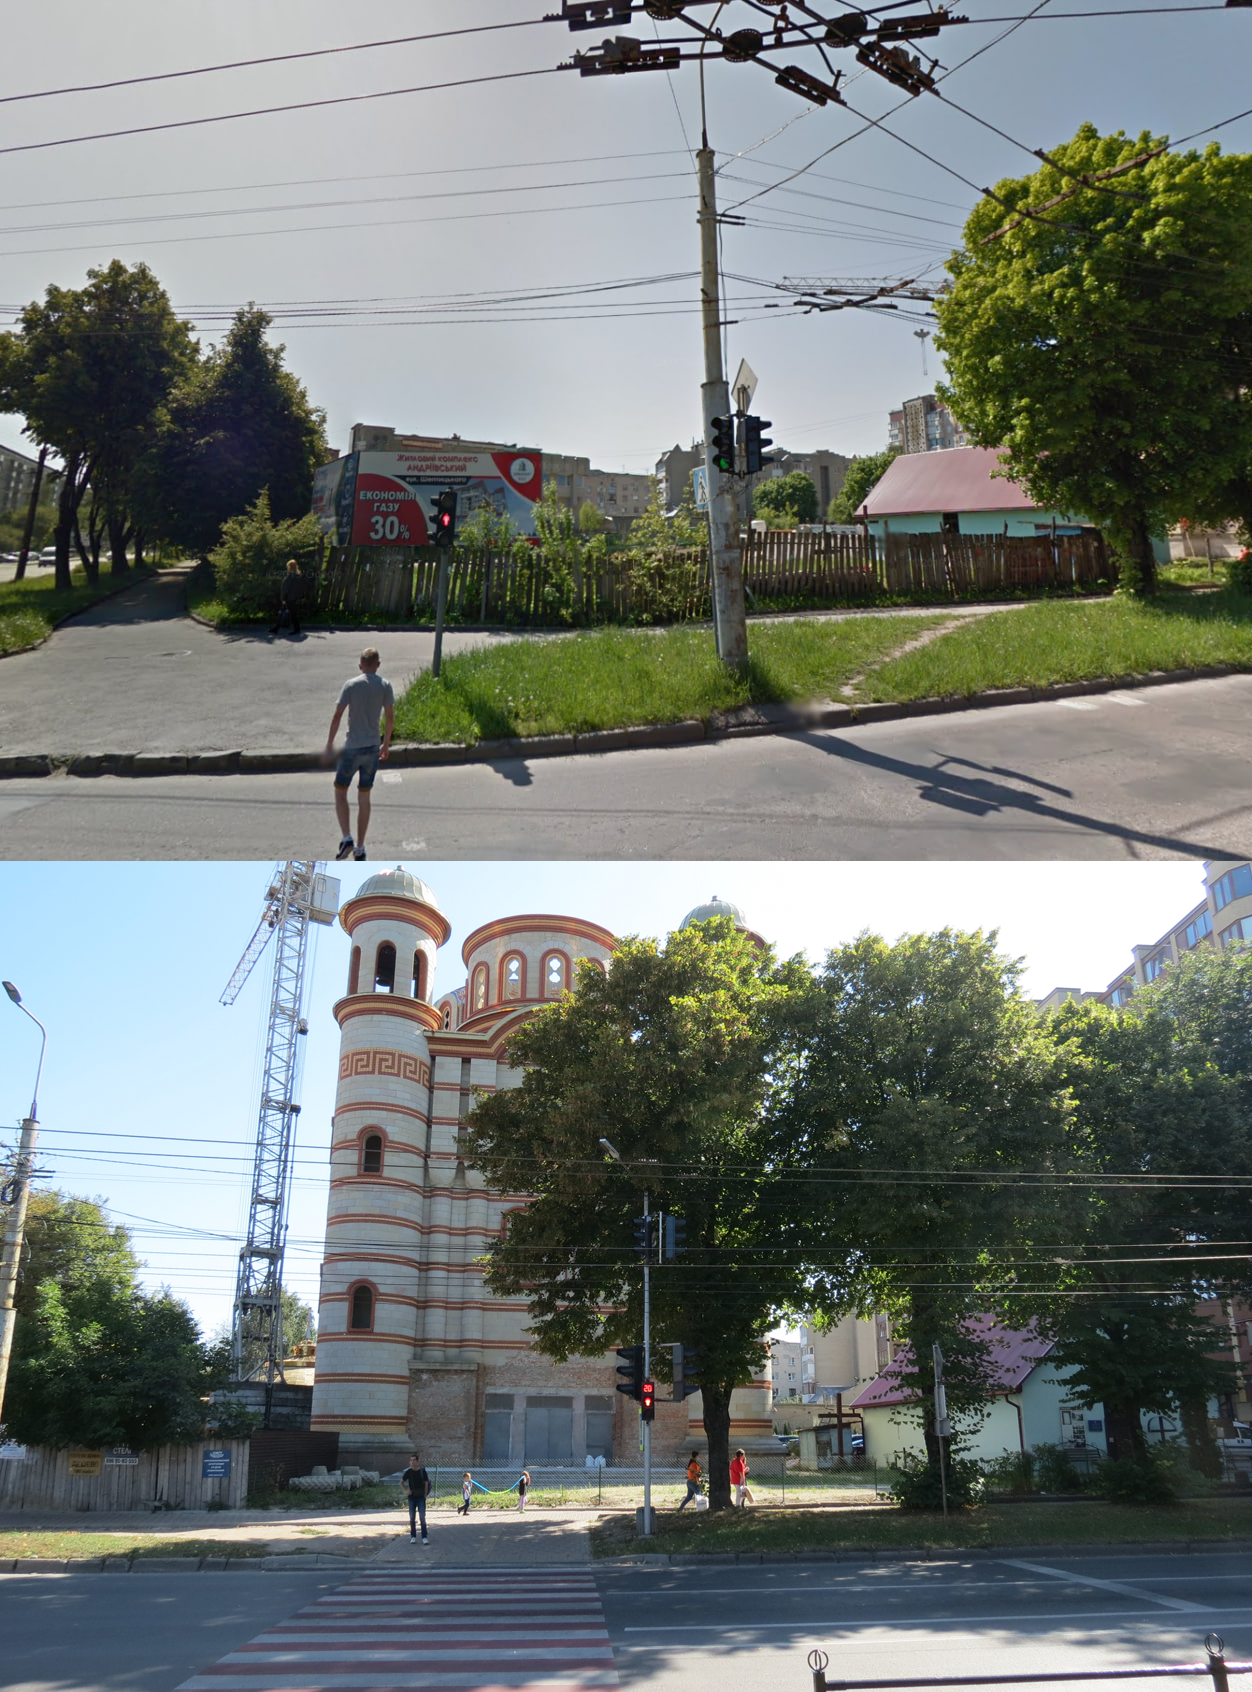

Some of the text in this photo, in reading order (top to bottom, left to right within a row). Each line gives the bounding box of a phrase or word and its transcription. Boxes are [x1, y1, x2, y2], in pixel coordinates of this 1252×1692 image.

[360, 491, 416, 500] ЕКОНОМІЯ
[373, 503, 399, 512] ГАЗУ
[369, 515, 410, 540] 30%
[642, 1384, 653, 1392] 20
